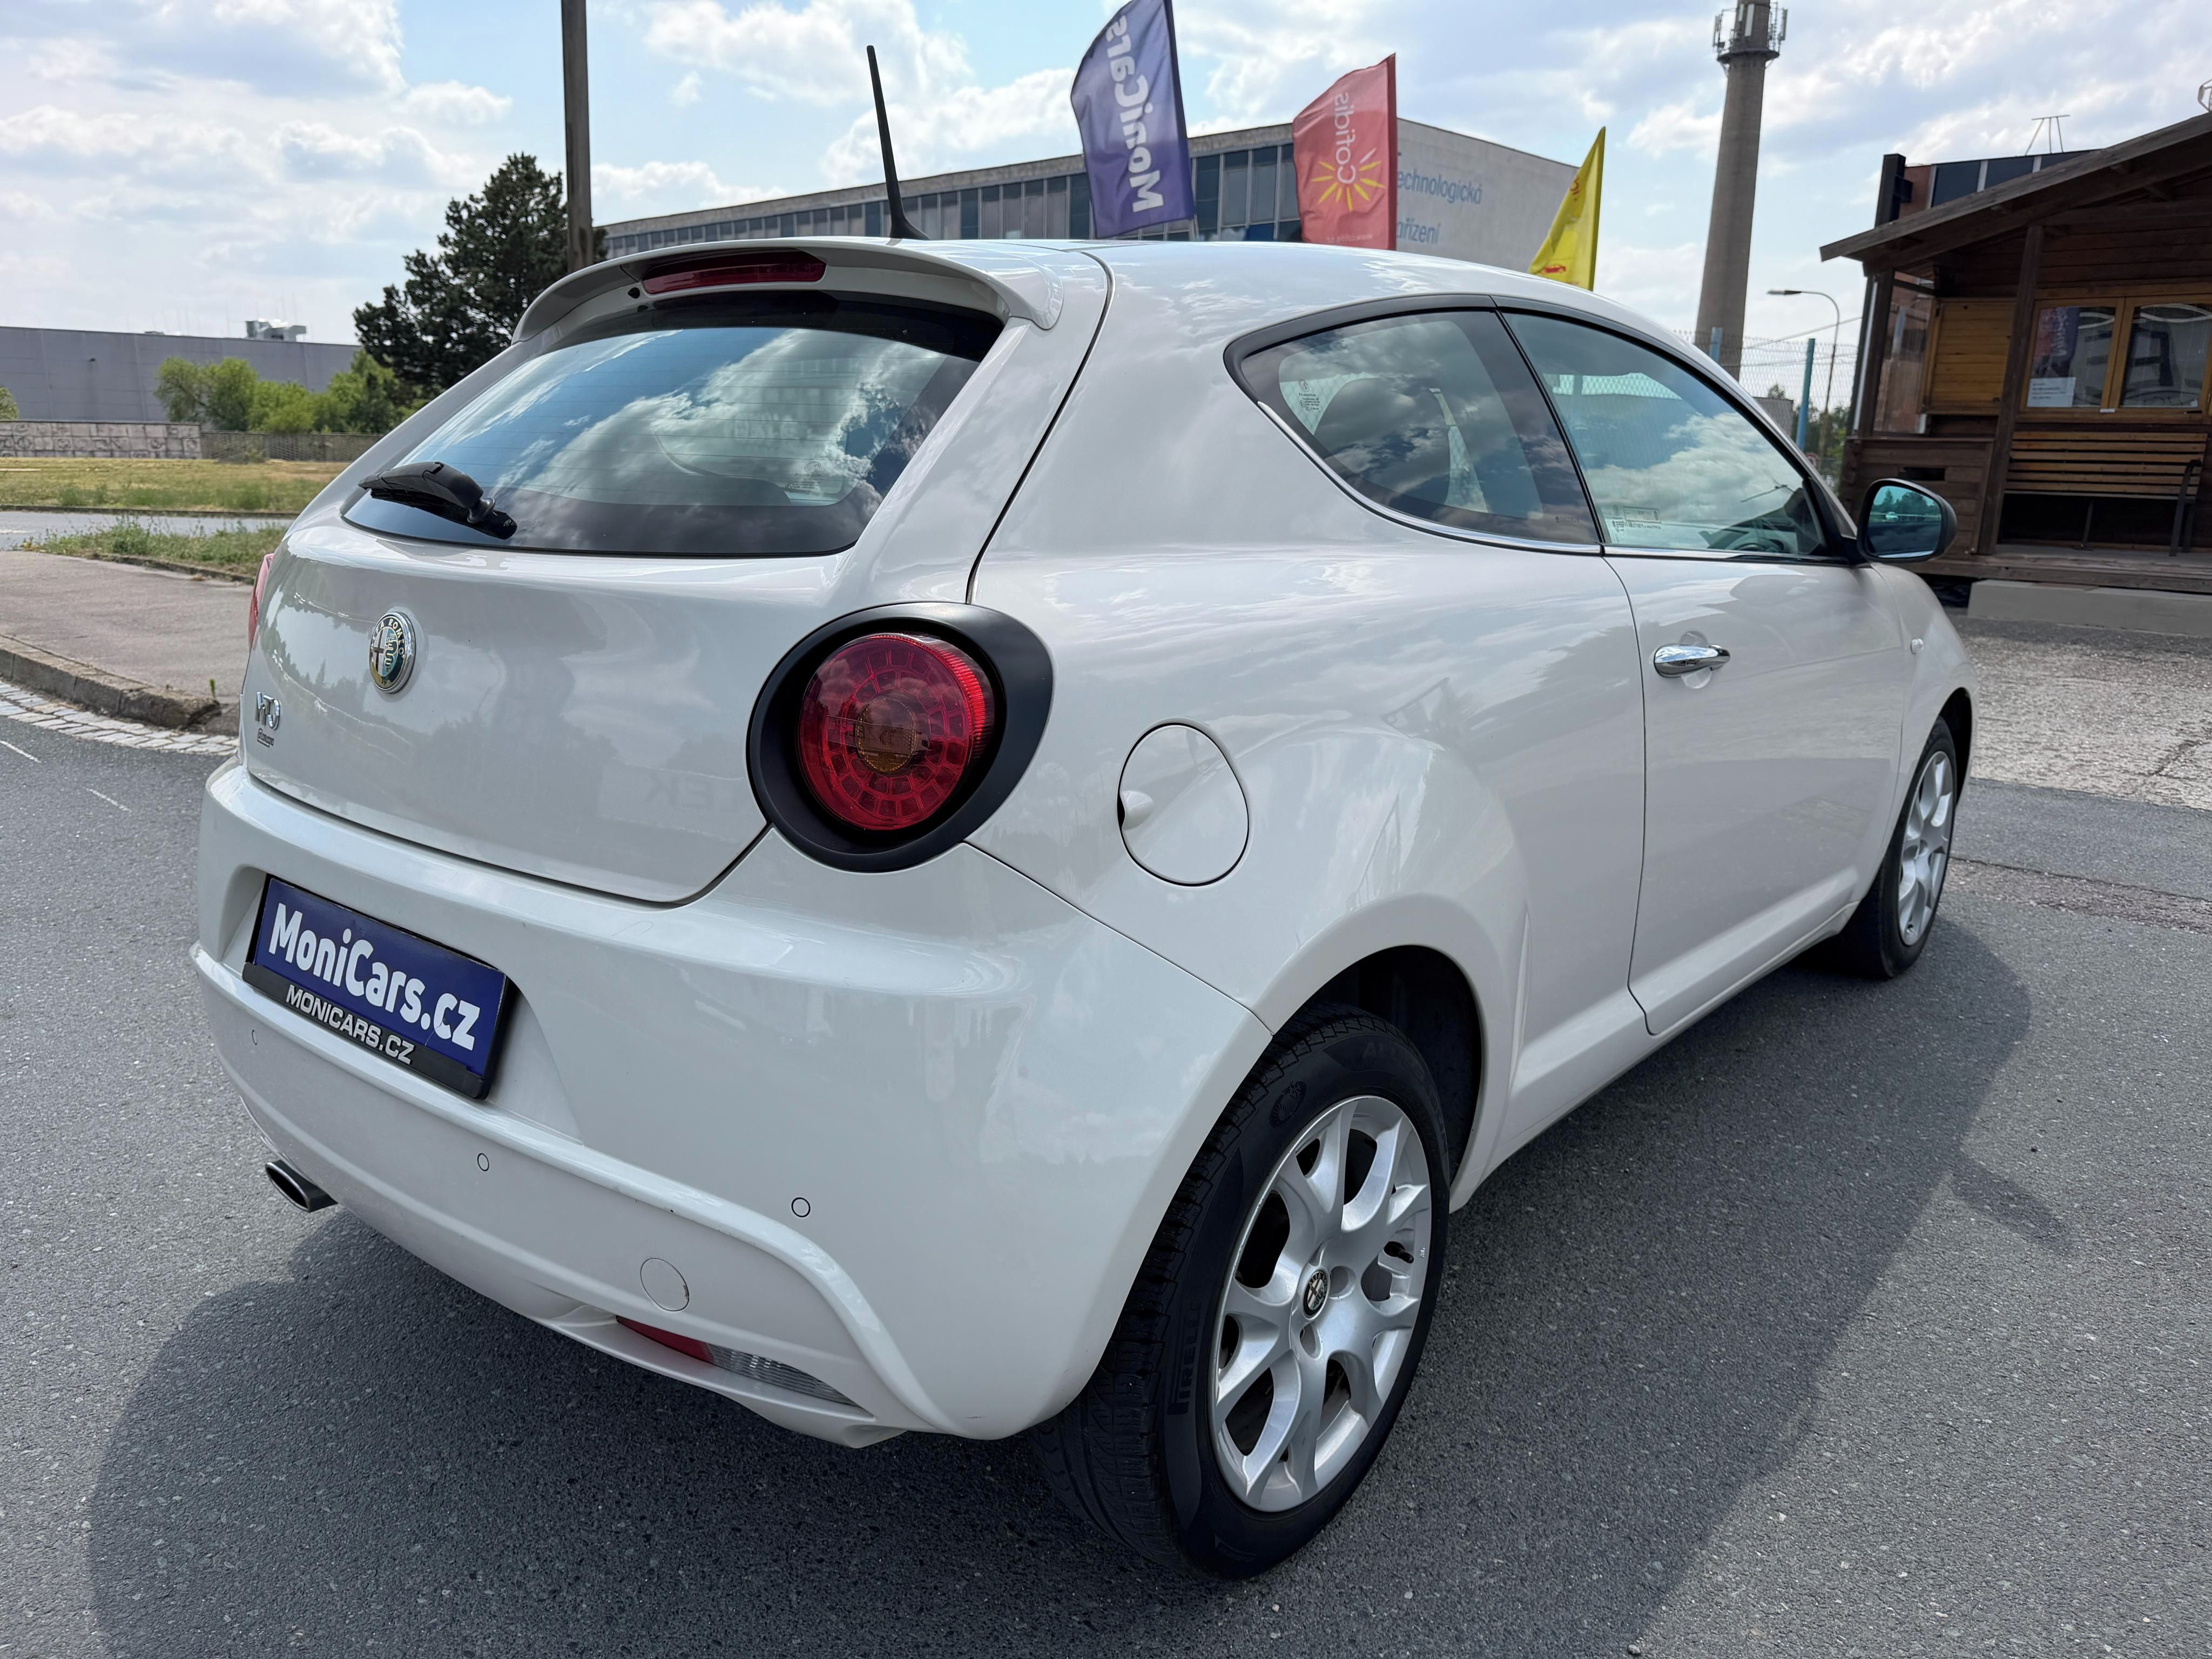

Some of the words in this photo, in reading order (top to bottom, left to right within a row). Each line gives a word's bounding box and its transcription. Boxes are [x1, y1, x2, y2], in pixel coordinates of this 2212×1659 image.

[1397, 167, 1482, 204] echnologická
[1397, 218, 1441, 244] ařízení
[388, 618, 404, 655] ROMEO
[269, 903, 480, 1050] MoniCars.cz
[286, 984, 415, 1065] MONICARS.CZ
